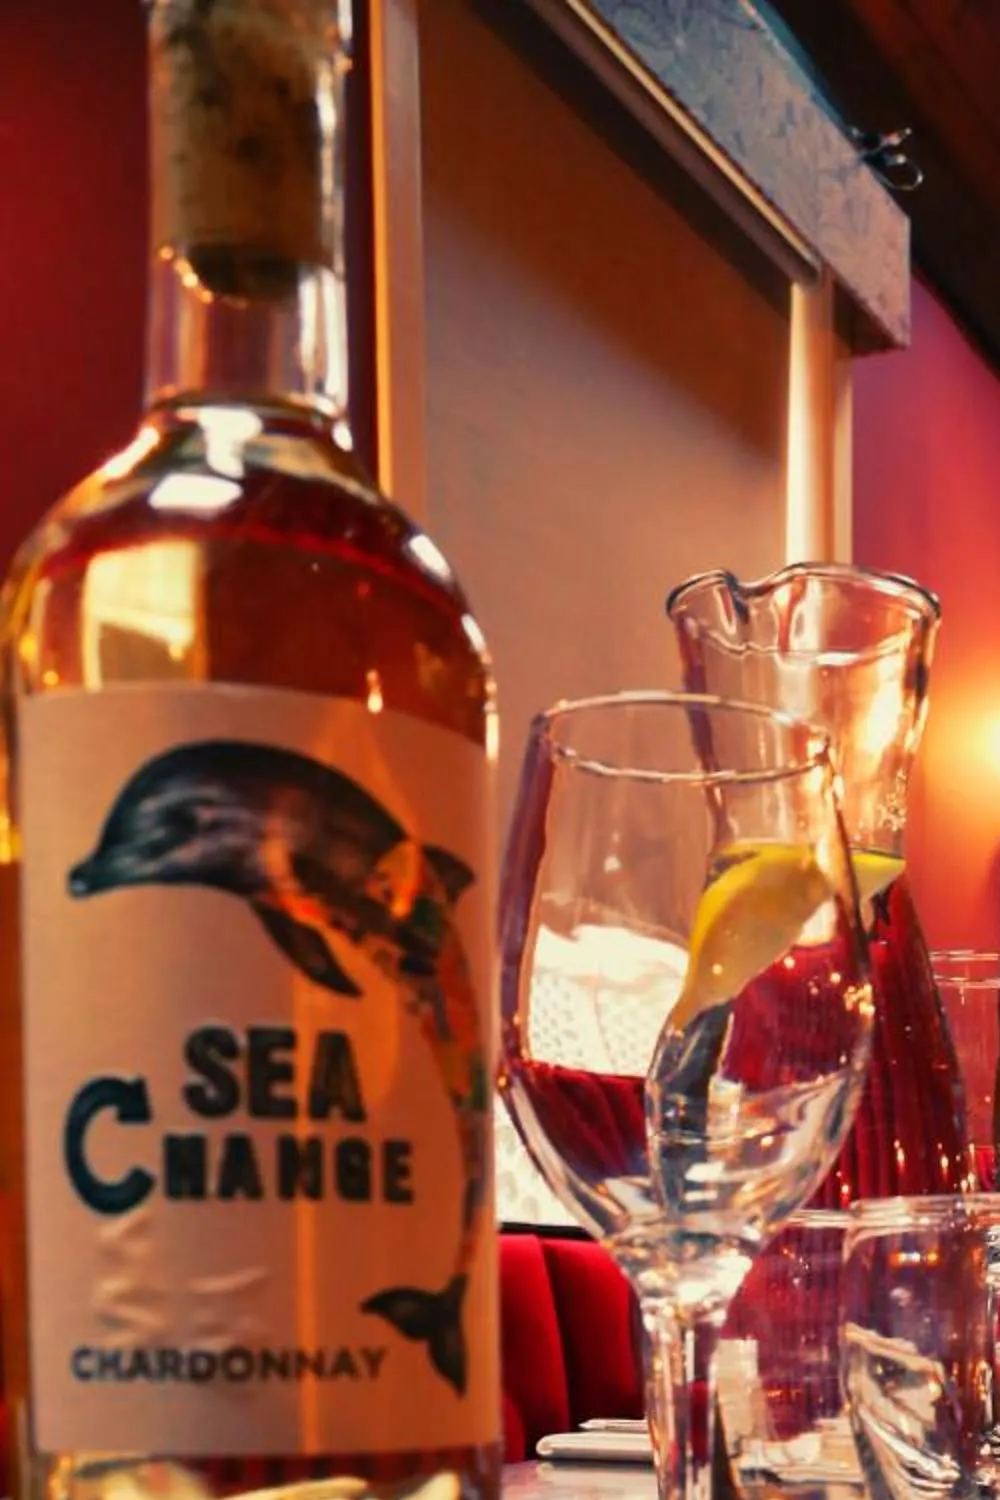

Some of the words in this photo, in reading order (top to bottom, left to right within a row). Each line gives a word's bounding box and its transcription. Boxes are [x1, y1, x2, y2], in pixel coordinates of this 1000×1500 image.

[183, 1026, 367, 1122] SEA
[63, 1074, 416, 1216] CHANGE
[70, 1345, 388, 1386] CHARDONNAY
